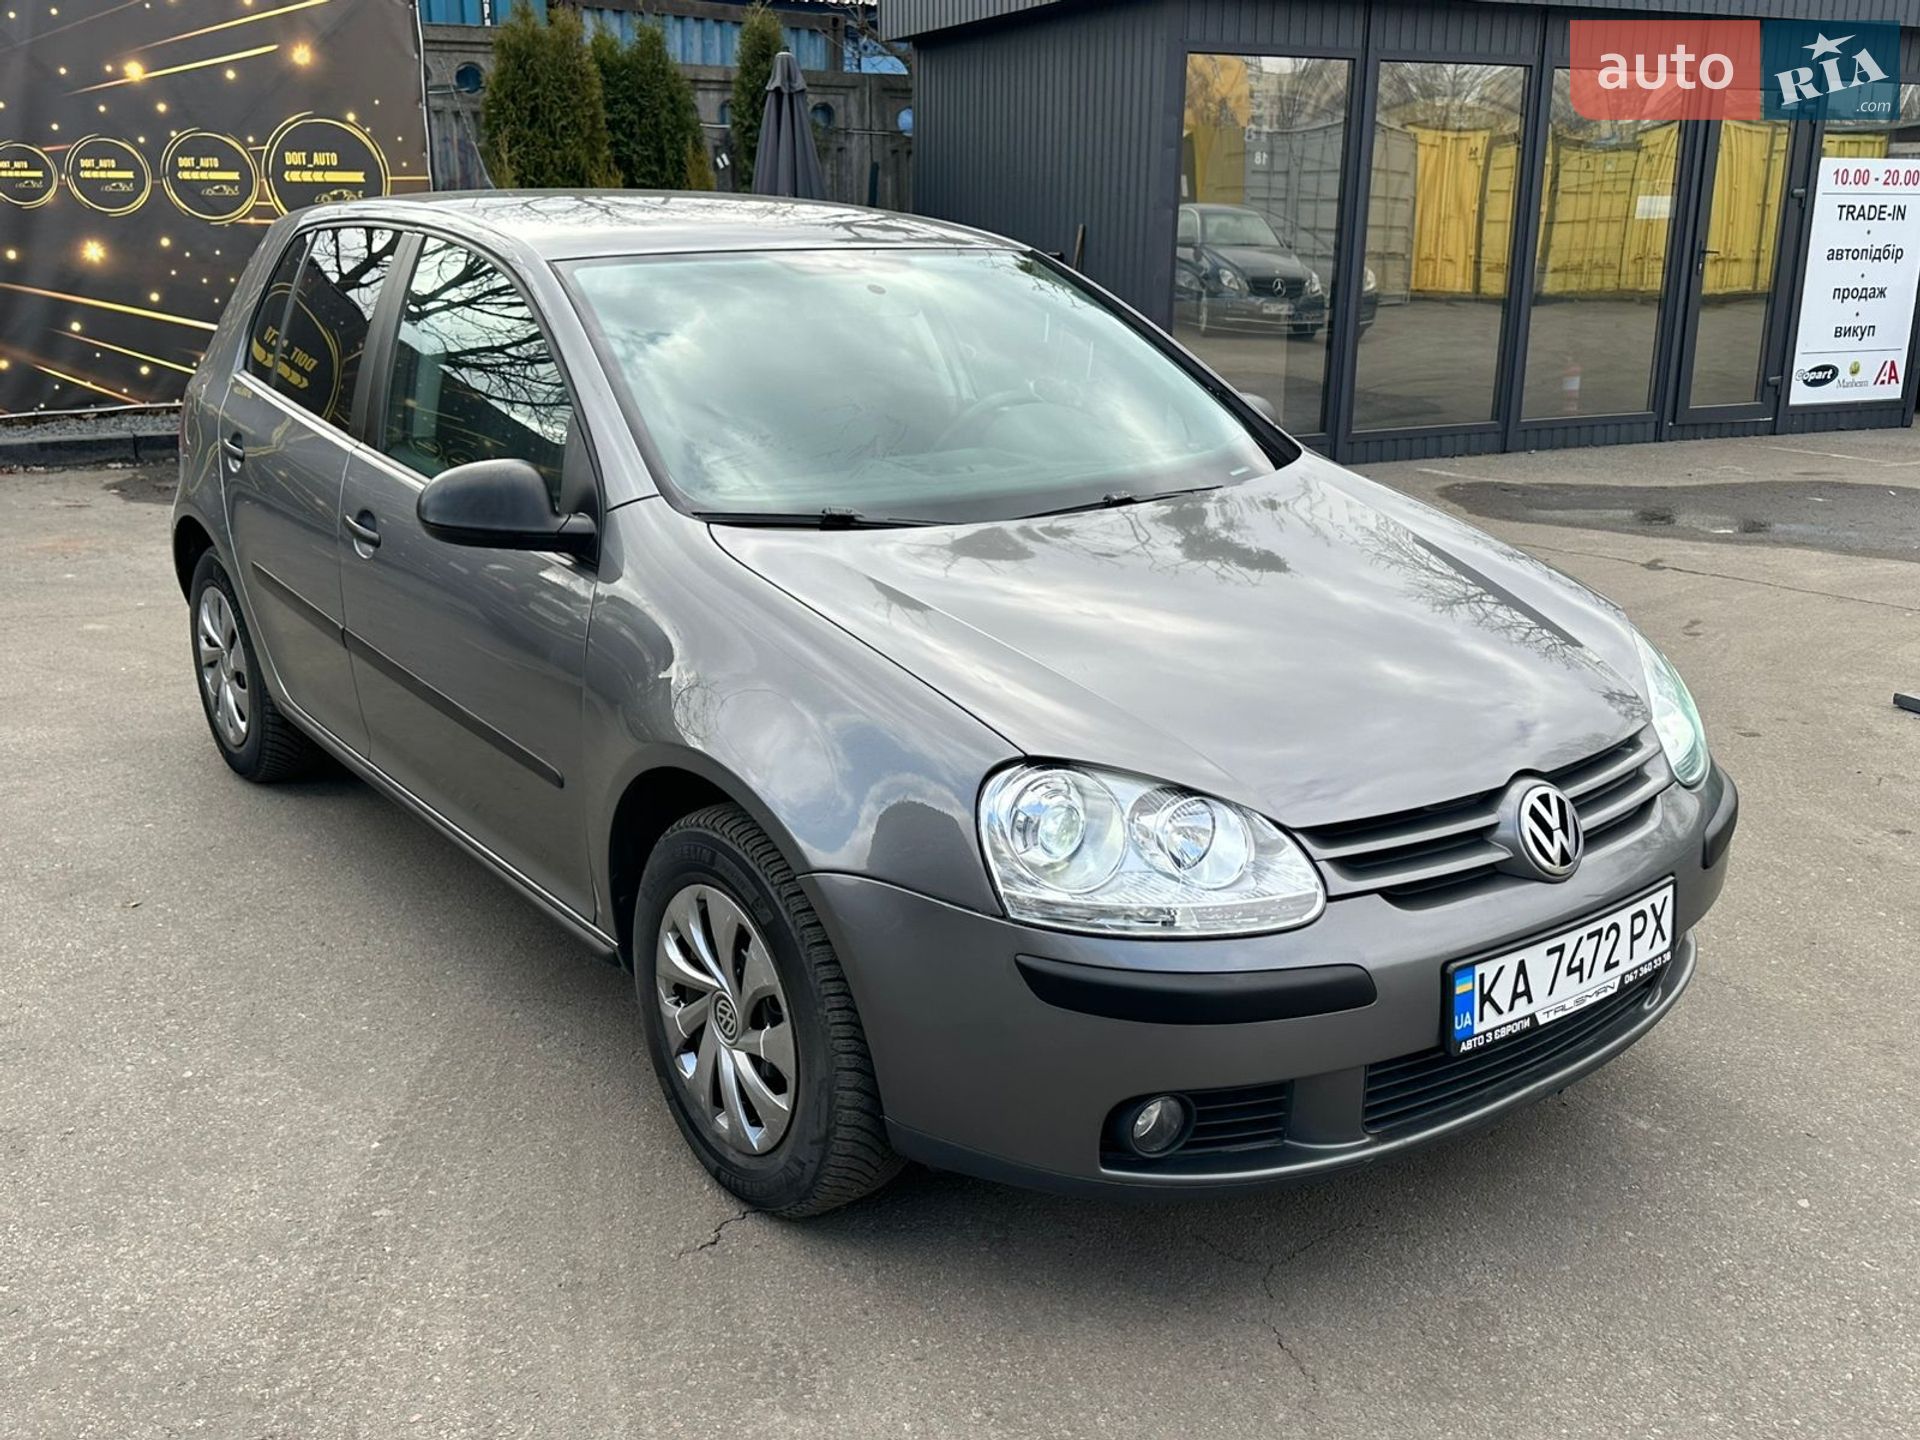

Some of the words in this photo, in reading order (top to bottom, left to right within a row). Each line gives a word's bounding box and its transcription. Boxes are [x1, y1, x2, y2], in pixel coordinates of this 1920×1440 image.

[285, 151, 338, 167] DOIT_AUTO
[1833, 168, 1870, 186] 10.00
[1882, 169, 1920, 186] 20.00
[1837, 204, 1907, 221] TRADE-IN
[1826, 243, 1904, 263] автопідбір
[1832, 286, 1888, 303] продаж
[1833, 324, 1876, 341] викуп
[1795, 368, 1833, 382] Copart
[1478, 958, 1534, 1023] KA
[1546, 922, 1621, 997] 7472
[1629, 896, 1668, 960] PX
[1624, 969, 1639, 984] 067
[1542, 981, 1616, 1019] TALISMAN
[1454, 1011, 1472, 1030] UA
[1459, 1033, 1484, 1053] АВТО
[1494, 1017, 1530, 1040] ЄВРОПИ
